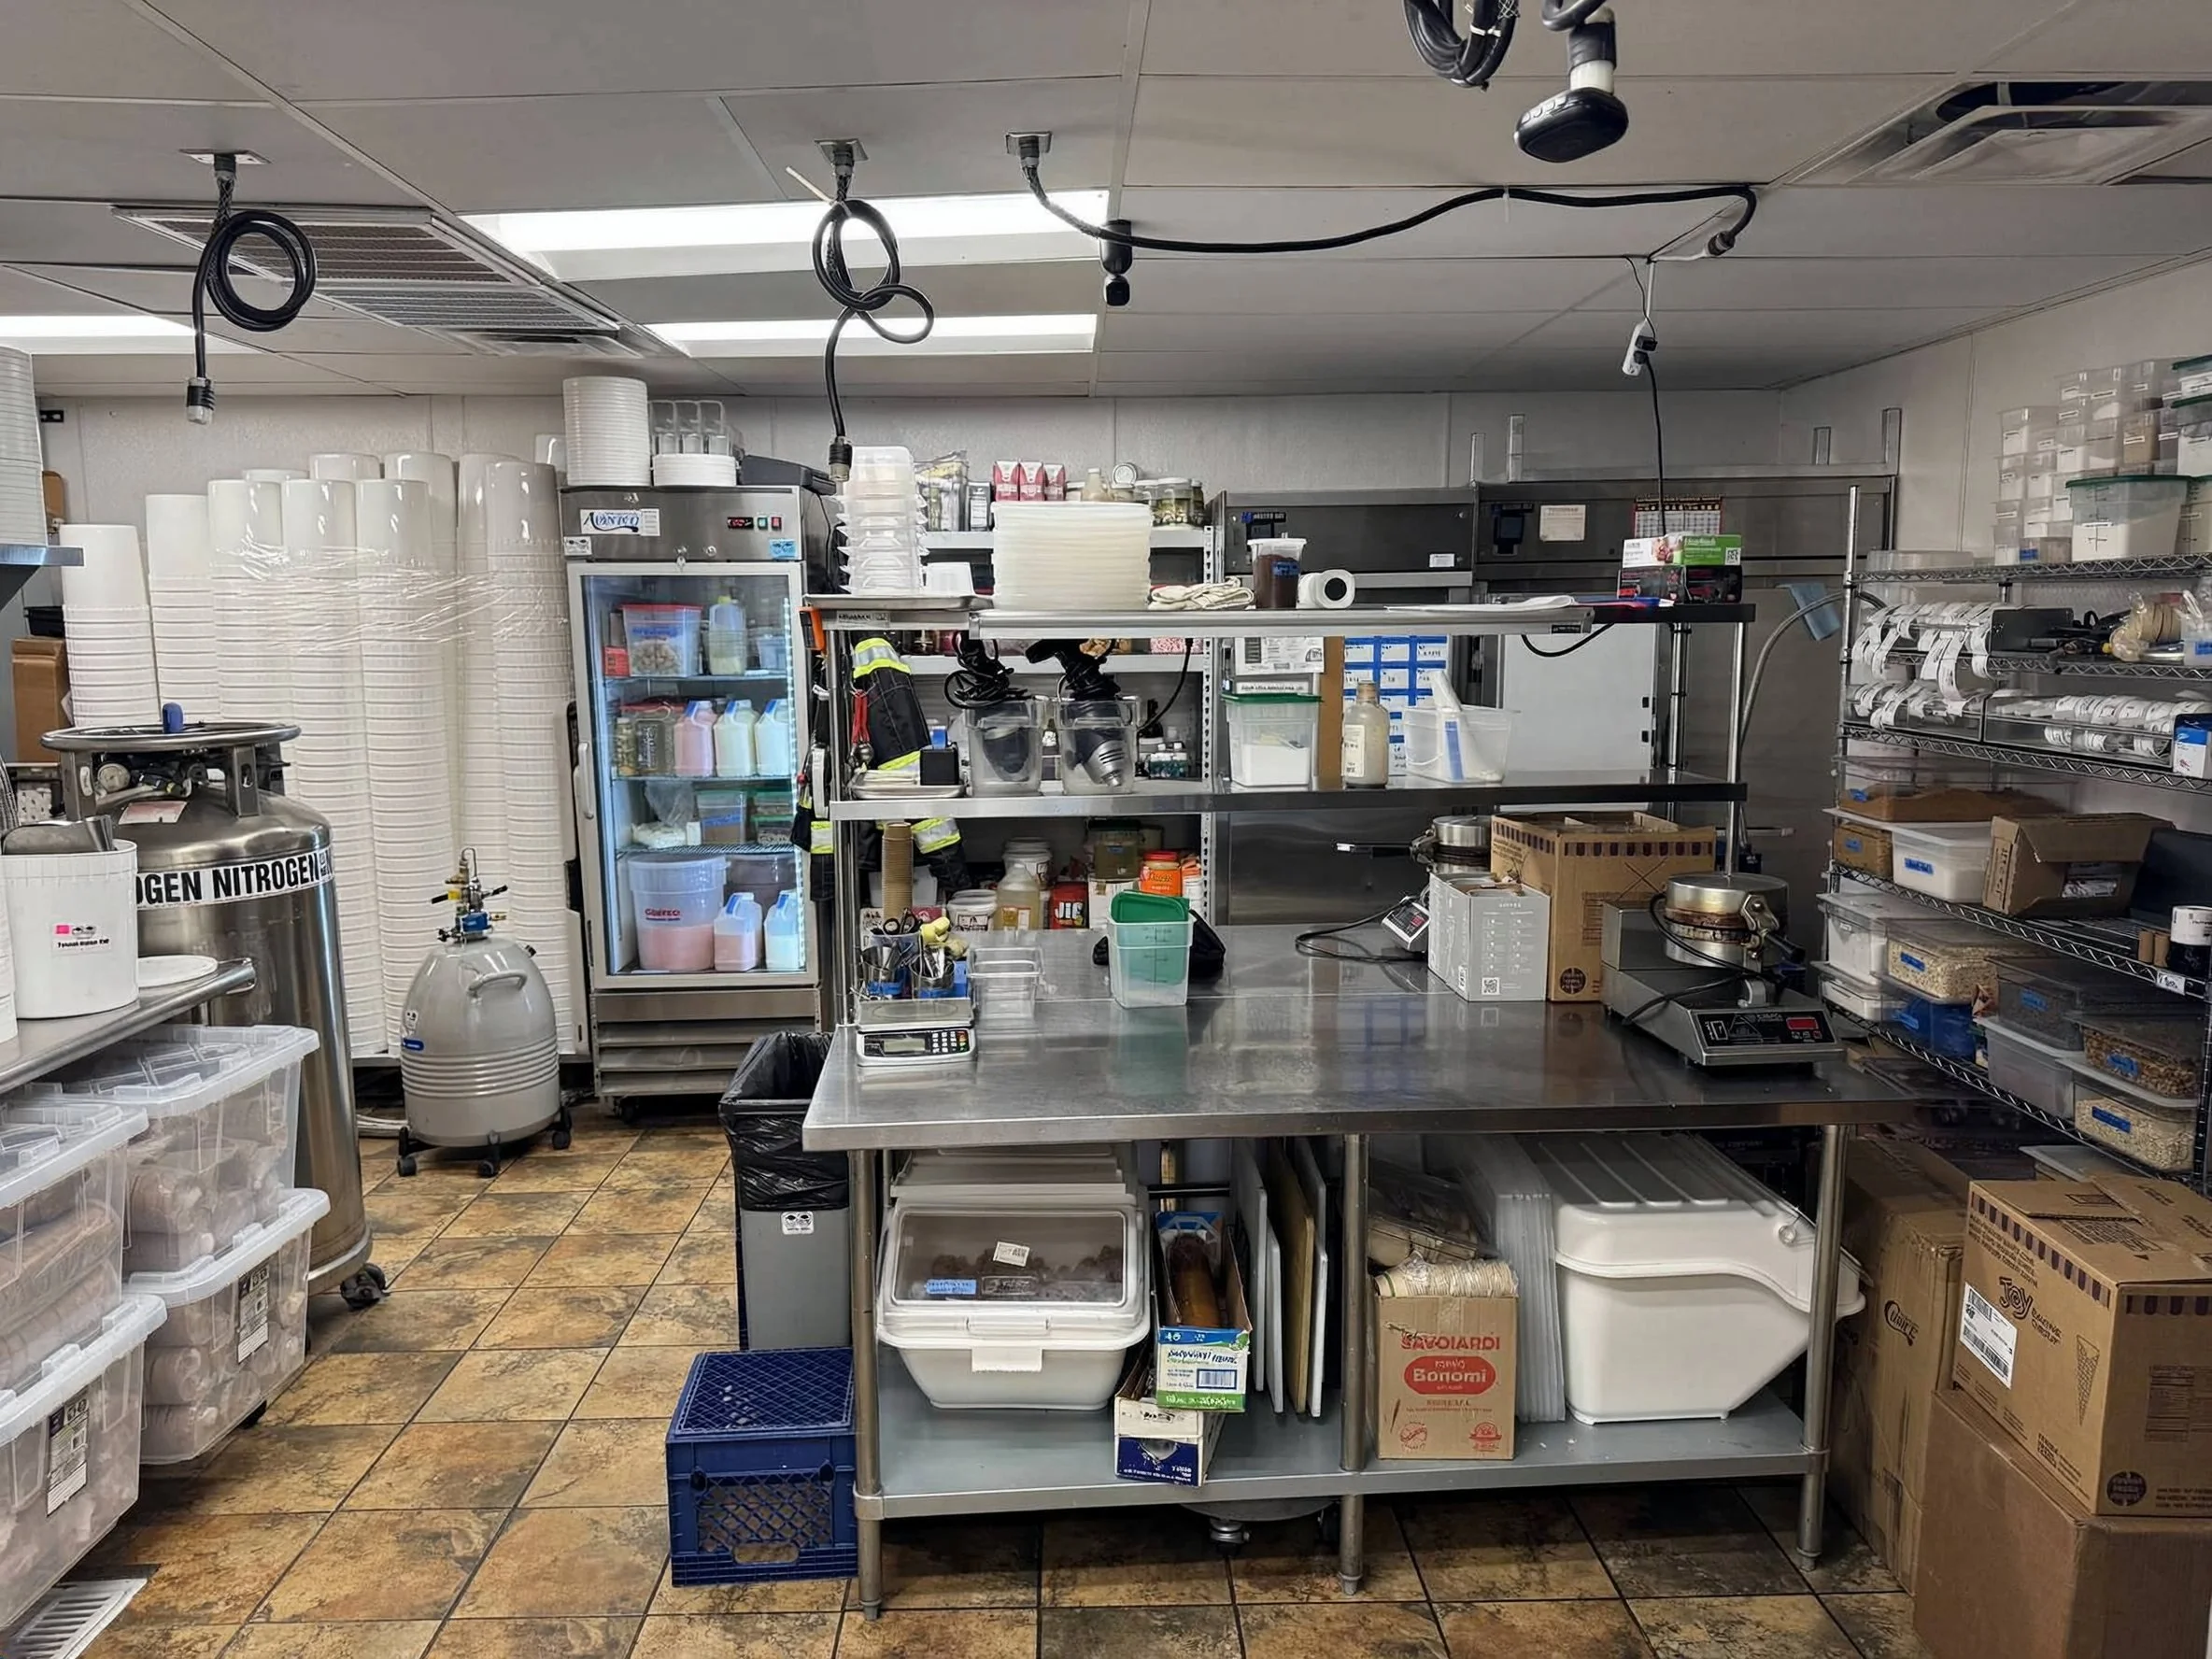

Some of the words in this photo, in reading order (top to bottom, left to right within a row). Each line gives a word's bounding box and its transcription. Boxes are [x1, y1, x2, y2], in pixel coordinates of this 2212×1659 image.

[213, 852, 319, 899] NITROGEN
[1400, 1333, 1500, 1350] SAVOIARDI
[1412, 1368, 1487, 1383] Bonomi
